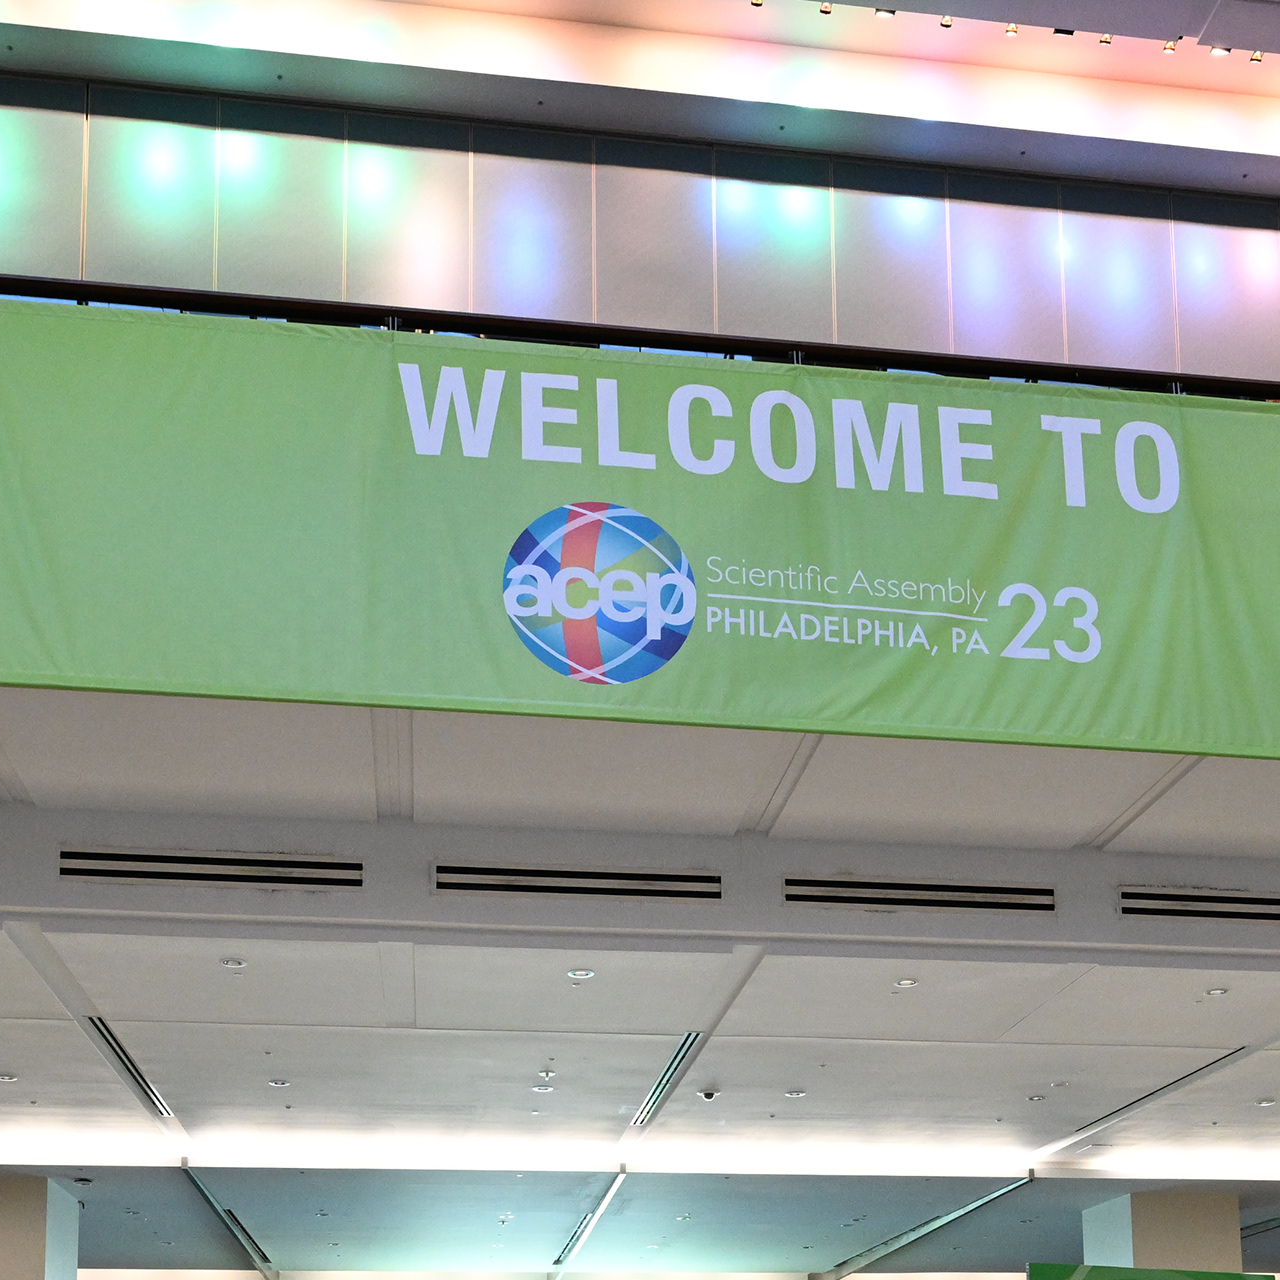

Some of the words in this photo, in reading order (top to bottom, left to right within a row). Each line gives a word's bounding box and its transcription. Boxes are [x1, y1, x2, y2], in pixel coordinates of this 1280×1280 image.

[397, 362, 999, 501] WELCOME
[1041, 414, 1181, 514] TO
[503, 561, 696, 640] acep
[706, 556, 842, 596] Scientific
[847, 569, 987, 615] Assembly
[997, 582, 1102, 663] 23
[706, 606, 939, 656] PHILADELPHIA,
[951, 627, 989, 656] PA
